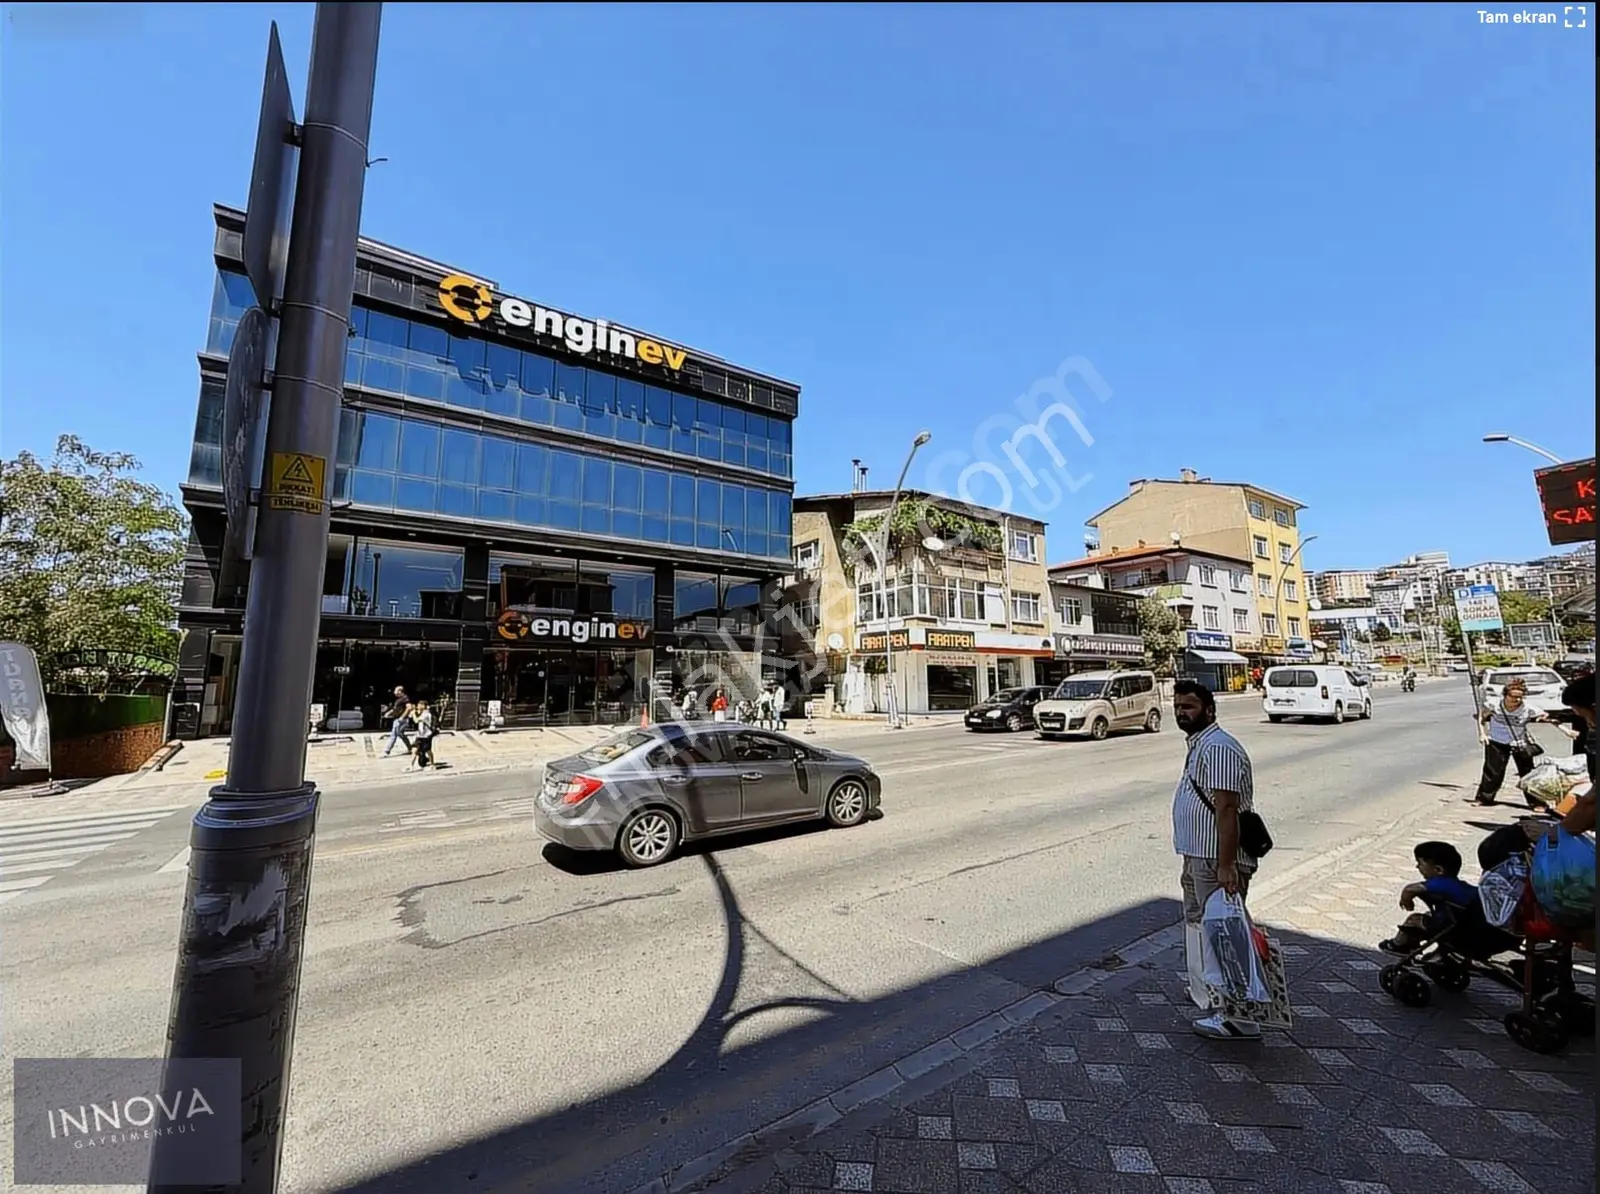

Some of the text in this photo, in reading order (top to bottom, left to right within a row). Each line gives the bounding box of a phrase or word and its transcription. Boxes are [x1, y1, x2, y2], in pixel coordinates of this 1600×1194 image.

[499, 298, 687, 370] enginev
[1553, 505, 1595, 524] SA
[530, 616, 650, 643] enginev
